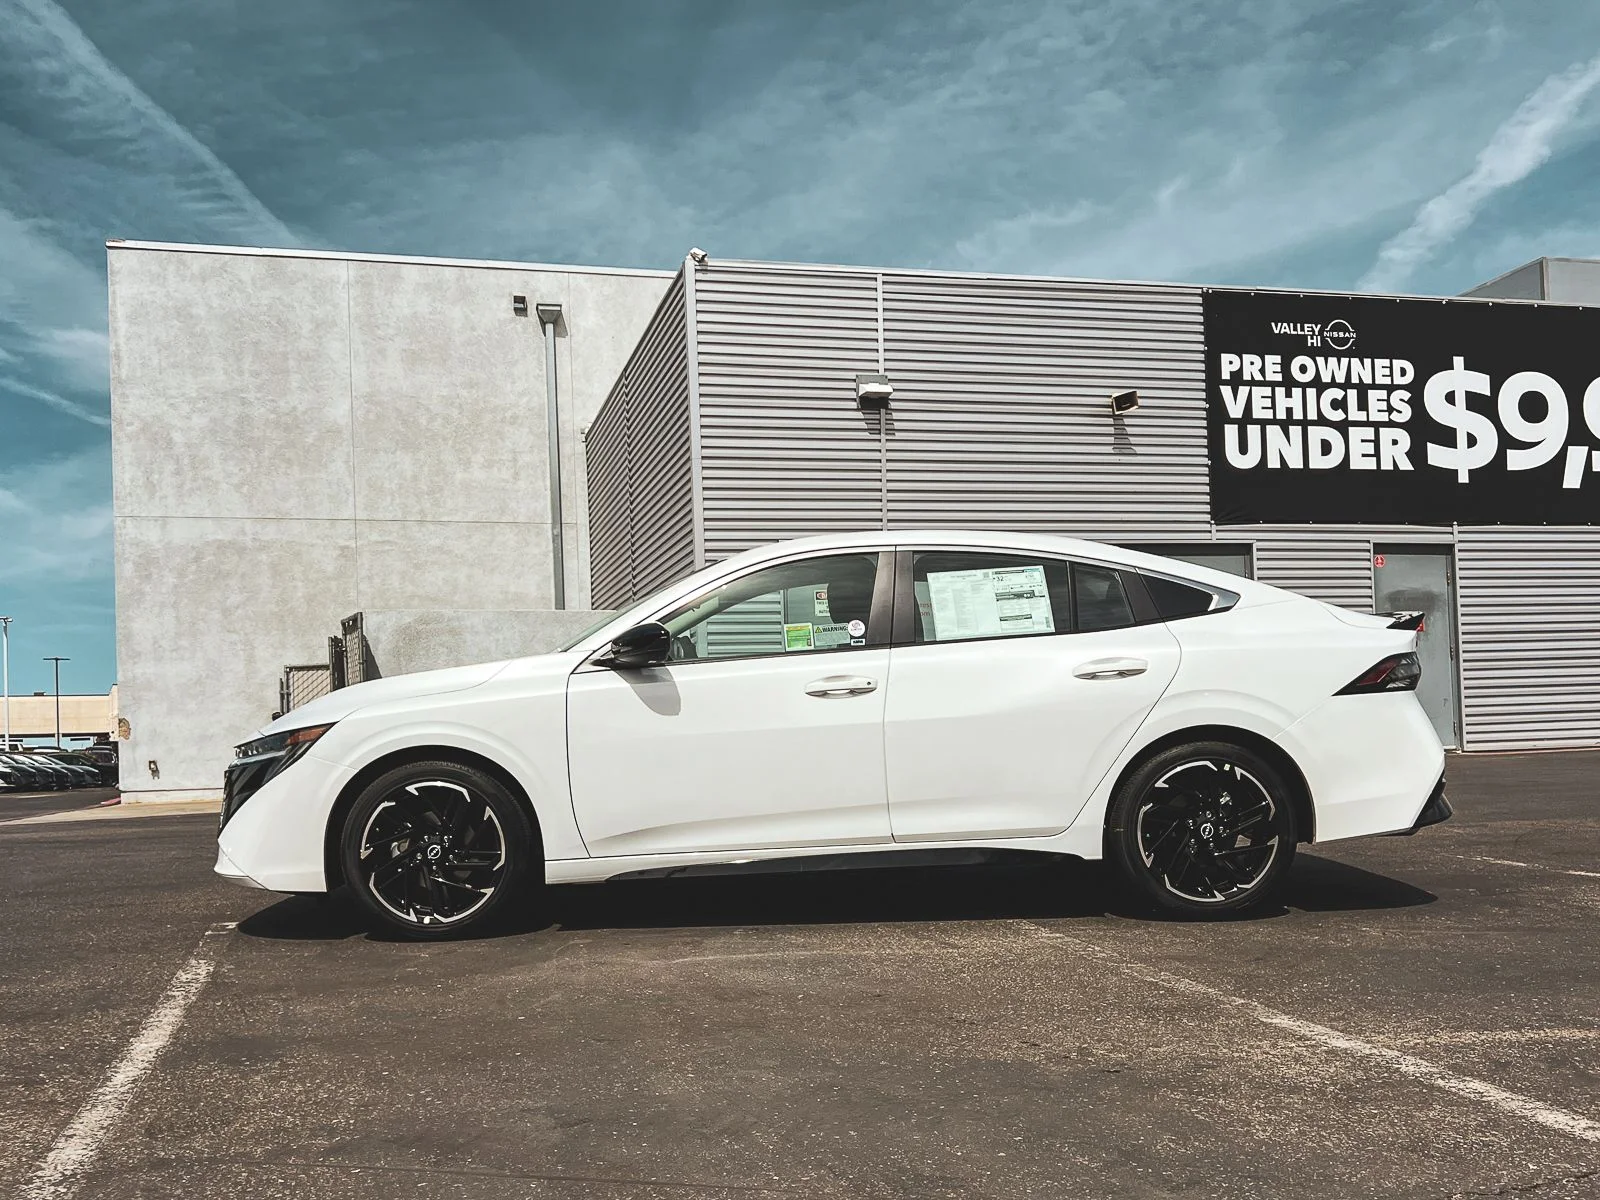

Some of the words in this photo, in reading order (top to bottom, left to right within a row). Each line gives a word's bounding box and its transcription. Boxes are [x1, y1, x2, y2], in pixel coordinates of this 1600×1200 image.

[1271, 322, 1321, 335] VALLEY
[1308, 336, 1321, 347] HI
[1220, 353, 1283, 381] PRE
[1290, 356, 1415, 385] OWNED
[1219, 385, 1412, 422] VEHICLES
[1424, 356, 1600, 488] $9,
[1224, 424, 1415, 470] UNDER
